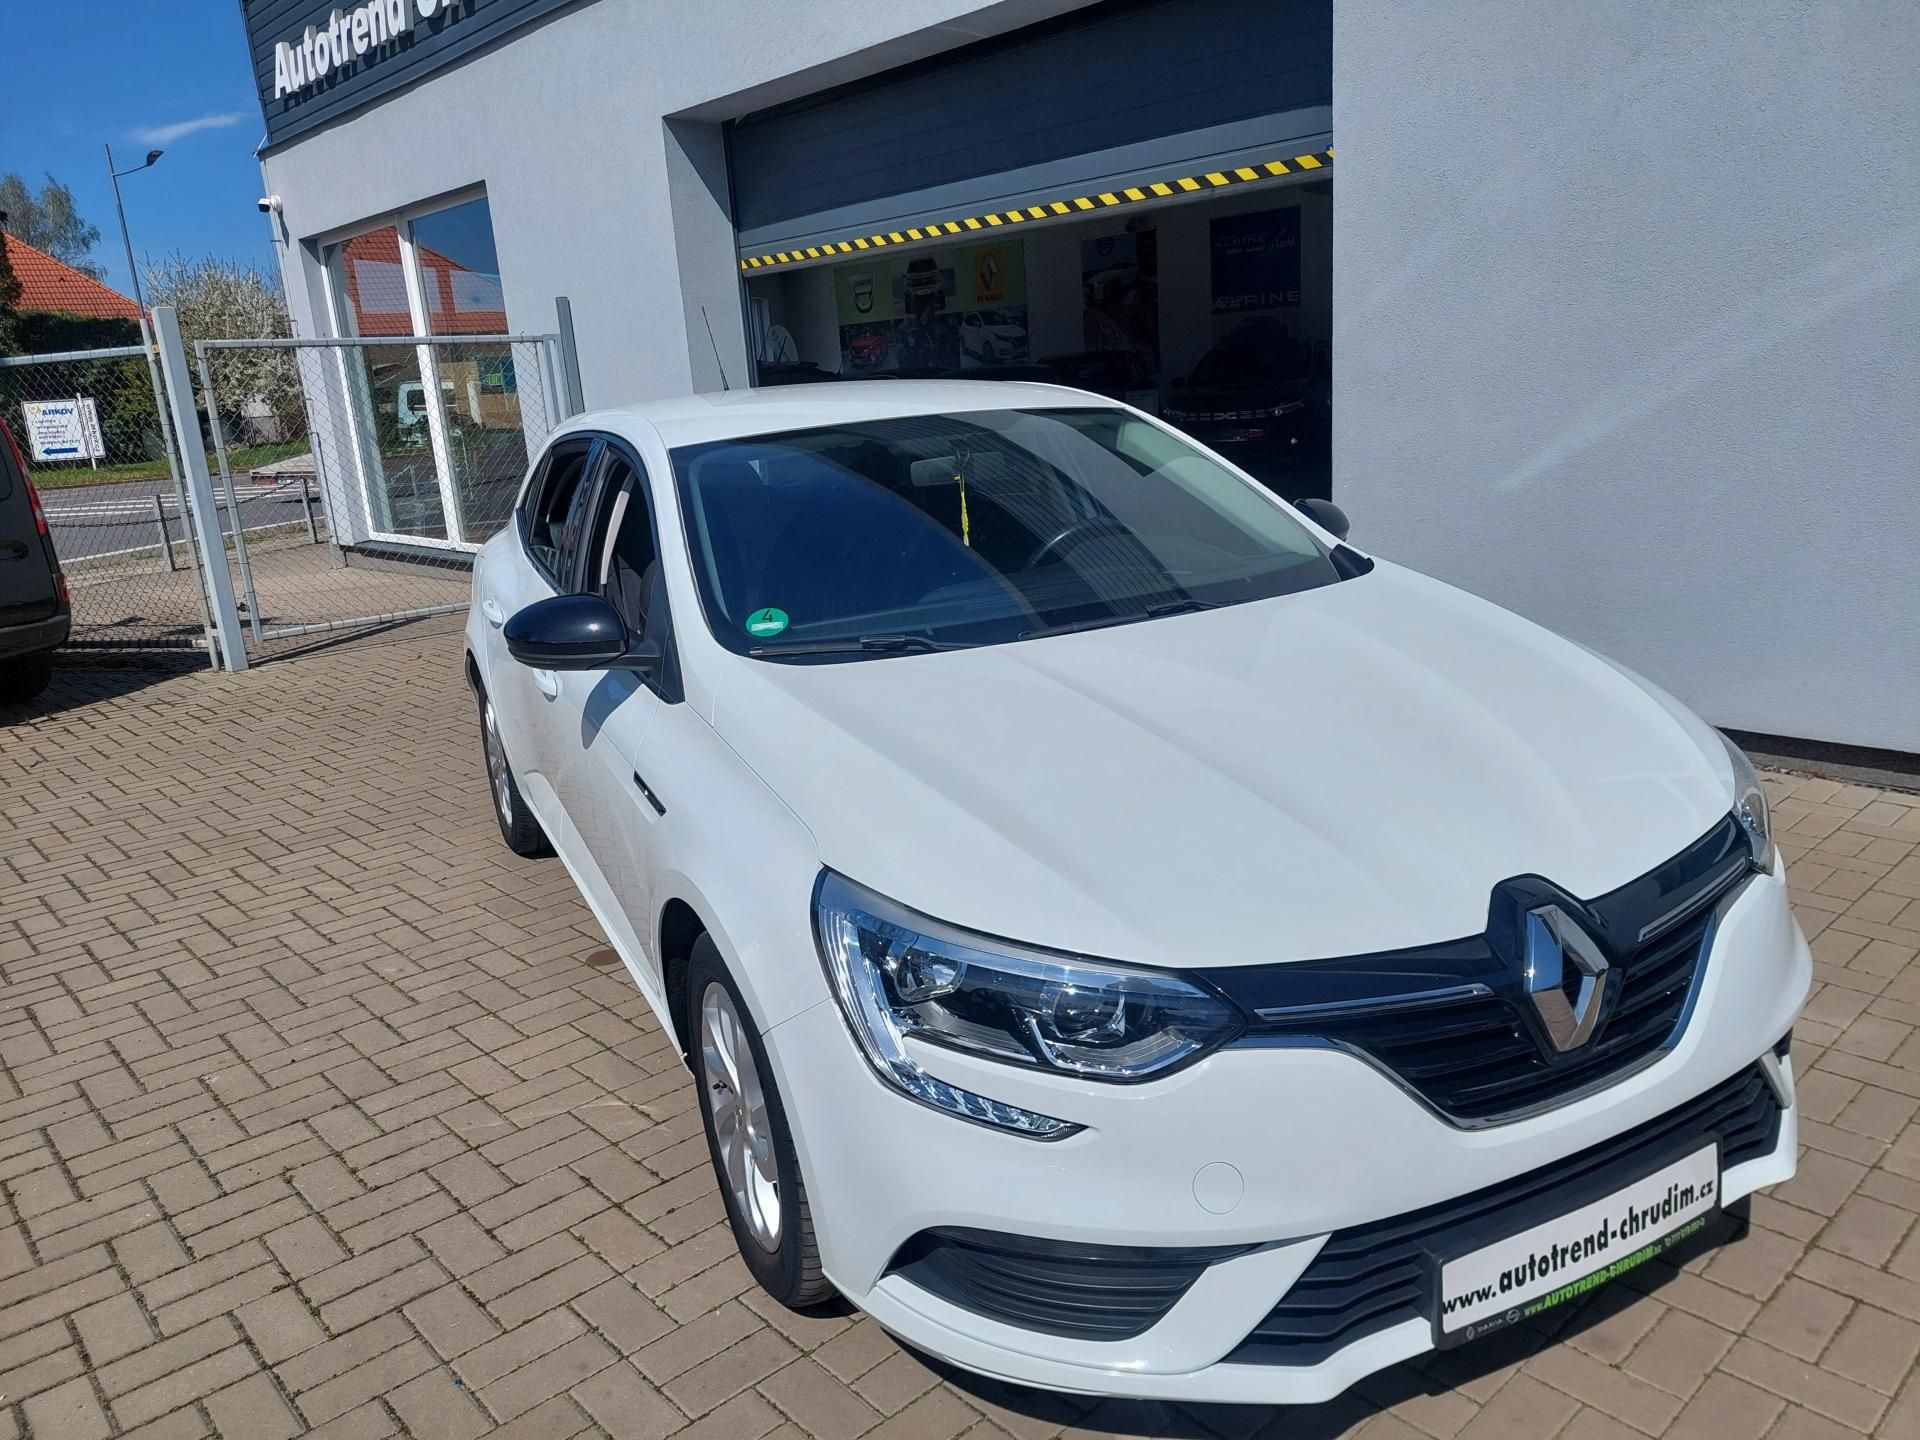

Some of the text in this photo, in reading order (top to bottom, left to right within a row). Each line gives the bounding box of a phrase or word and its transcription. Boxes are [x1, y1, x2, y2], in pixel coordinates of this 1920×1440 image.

[275, 0, 407, 100] Autotrend
[41, 408, 74, 416] ARKOV
[762, 609, 774, 622] 4
